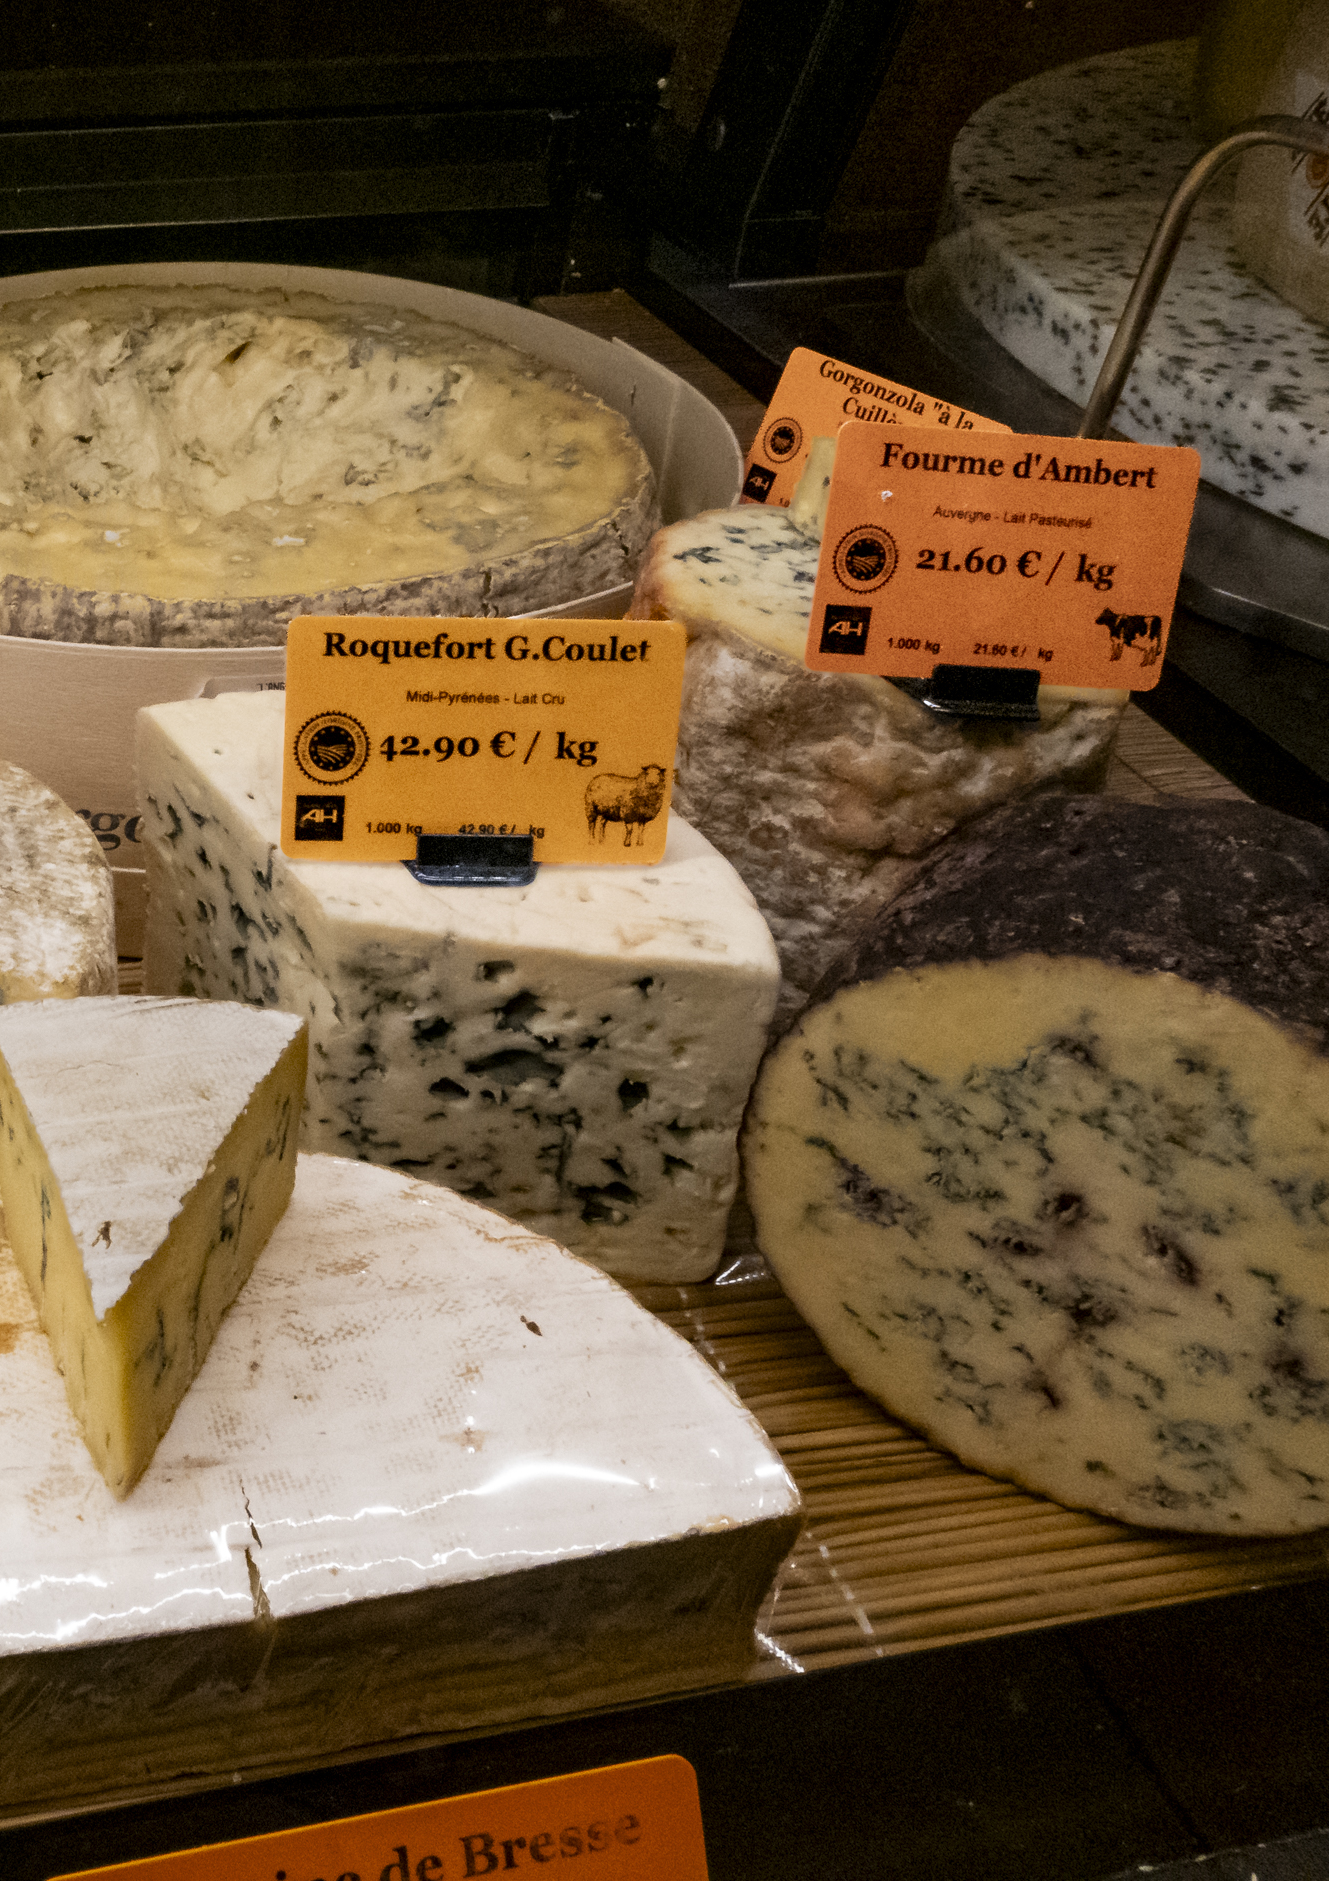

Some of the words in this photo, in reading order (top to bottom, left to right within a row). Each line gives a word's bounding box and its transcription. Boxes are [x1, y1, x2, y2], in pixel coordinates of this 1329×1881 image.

[819, 359, 926, 416] Gorgonzola
[954, 411, 974, 430] la
[879, 442, 1004, 477] Fourme
[1013, 453, 1158, 490] d'Ambert
[932, 505, 991, 524] Auvergne
[1003, 511, 1026, 523] Lait
[915, 546, 1007, 577] 21.60
[1017, 550, 1042, 578] €
[1073, 553, 1117, 592] kg
[323, 632, 496, 664] Roquefort
[505, 634, 651, 662] G.Coulet
[887, 637, 921, 650] 1.000
[925, 640, 940, 654] kg
[1037, 647, 1054, 662] kg
[406, 690, 500, 706] Midi-Pyrénées
[513, 692, 537, 705] Lait
[542, 693, 566, 705] Cru
[380, 732, 480, 763] 42.90
[490, 731, 516, 758] €
[555, 731, 599, 767] kg
[366, 821, 401, 834] 1.000
[406, 823, 422, 836] kg
[528, 824, 545, 839] kg
[379, 1845, 443, 1881] de
[459, 1813, 641, 1879] Bresse
